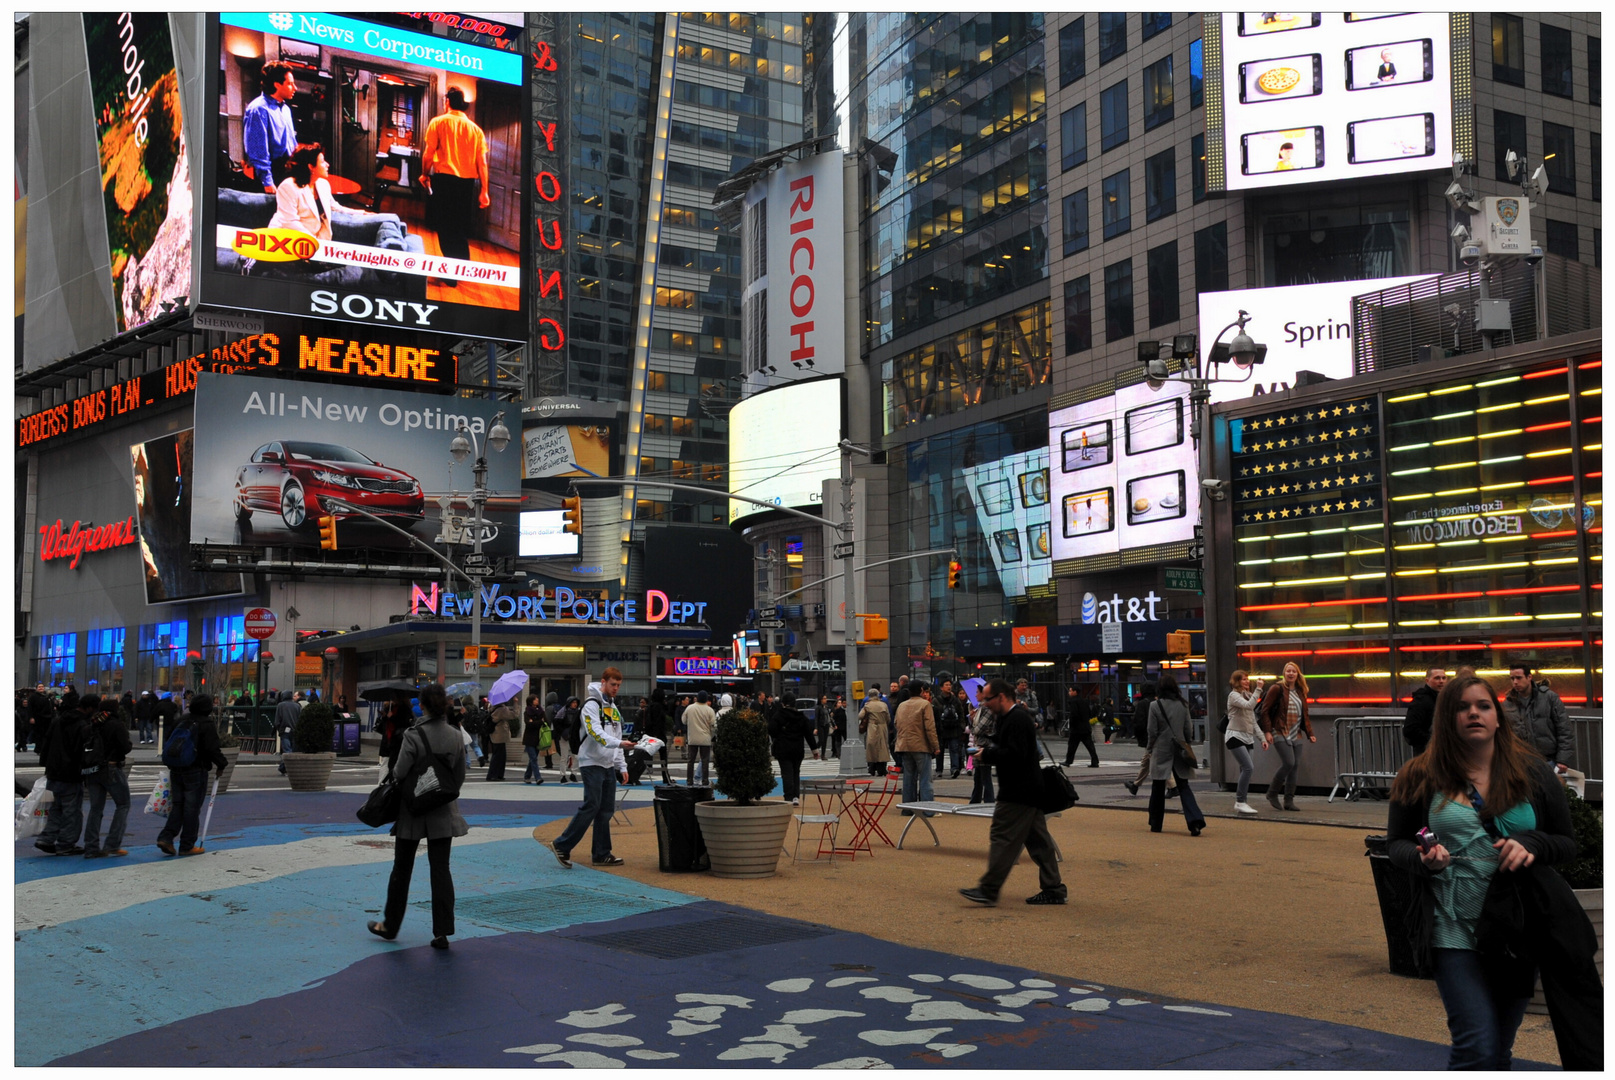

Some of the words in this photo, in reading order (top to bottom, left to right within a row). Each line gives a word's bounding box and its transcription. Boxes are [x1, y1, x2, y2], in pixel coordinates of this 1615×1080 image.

[299, 14, 354, 43] News
[363, 29, 484, 71] Corporation
[117, 12, 151, 148] mobile
[235, 230, 293, 256] PIX
[323, 245, 400, 268] Weeknights
[403, 257, 416, 269] @
[421, 260, 434, 272] 11
[438, 262, 449, 274] &
[453, 264, 507, 282] 11:30PM
[789, 174, 815, 361] RICOH
[310, 290, 438, 325] SONY
[196, 315, 262, 332] SHERWOOD
[1284, 318, 1350, 348] Sprin
[19, 403, 69, 446] BORDERS'S
[73, 390, 106, 429] BONUS
[111, 377, 140, 416] PLAN
[166, 353, 205, 398] HOUSE
[299, 335, 440, 382] MEASURE
[243, 391, 368, 424] All-New
[378, 402, 485, 434] Optima
[537, 403, 581, 411] UNIVERSAL
[525, 434, 541, 449] EVERY
[541, 425, 564, 441] GREAT
[526, 434, 565, 458] RESTAURANT
[529, 454, 569, 476] SOMEWHERE
[543, 446, 567, 461] STARTS
[39, 516, 136, 570] Walgreens
[571, 566, 603, 574] AQUOS
[1172, 579, 1177, 587] W
[1179, 580, 1187, 588] 43
[1189, 580, 1196, 588] ST
[411, 581, 474, 618] NEW
[480, 583, 547, 620] YORK
[555, 586, 636, 622] POLICE
[646, 589, 707, 624] DEPT
[1097, 590, 1161, 624] at&t
[1026, 635, 1040, 645] at&t
[600, 652, 639, 662] POLICE
[676, 658, 734, 673] CHAMPS
[788, 660, 841, 671] CHASE
[80, 765, 100, 776] NIKE
